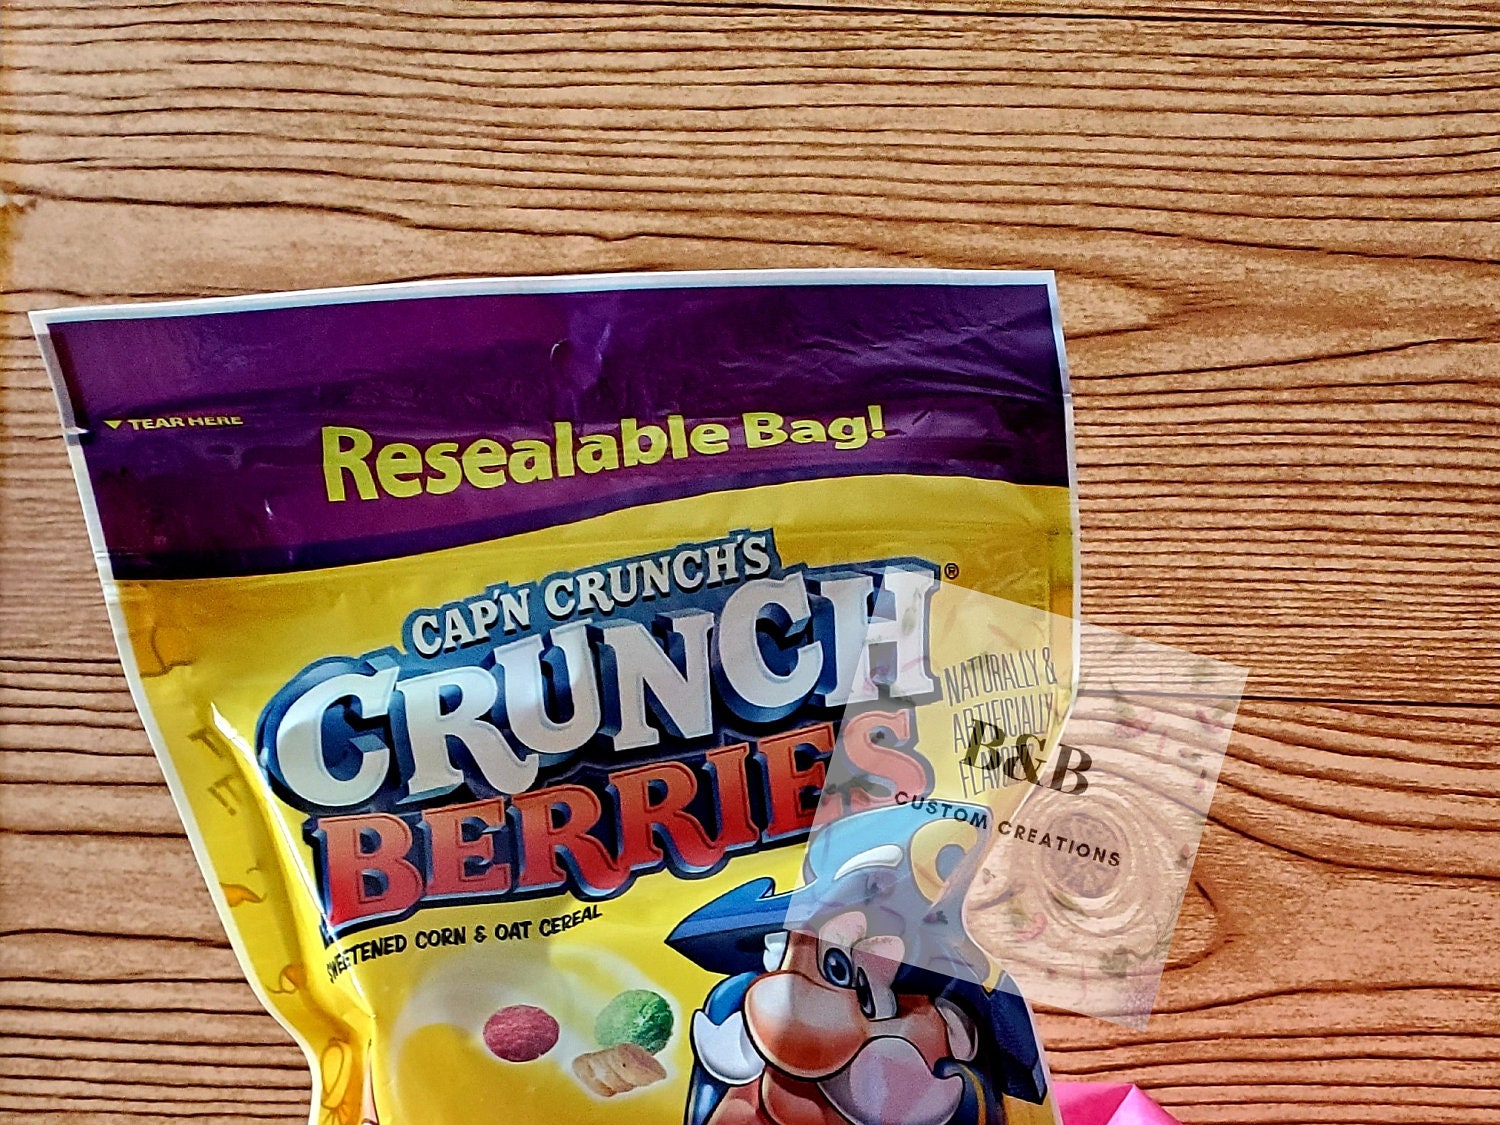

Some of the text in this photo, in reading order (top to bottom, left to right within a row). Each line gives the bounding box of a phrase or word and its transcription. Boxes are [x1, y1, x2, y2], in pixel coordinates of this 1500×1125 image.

[127, 416, 244, 431] TEAR HERE
[321, 404, 887, 502] Resealable Bag!
[411, 534, 772, 658] CAP'N CRUNCH'S
[270, 564, 940, 808] CRUNCH
[943, 646, 1059, 707] NATURALLY &
[952, 692, 1054, 753] ARTIFICIALLY
[318, 709, 932, 926] BERRIES
[415, 925, 467, 950] CORN
[473, 924, 488, 944] &
[494, 920, 533, 942] OAT
[538, 904, 604, 937] CEREAL
